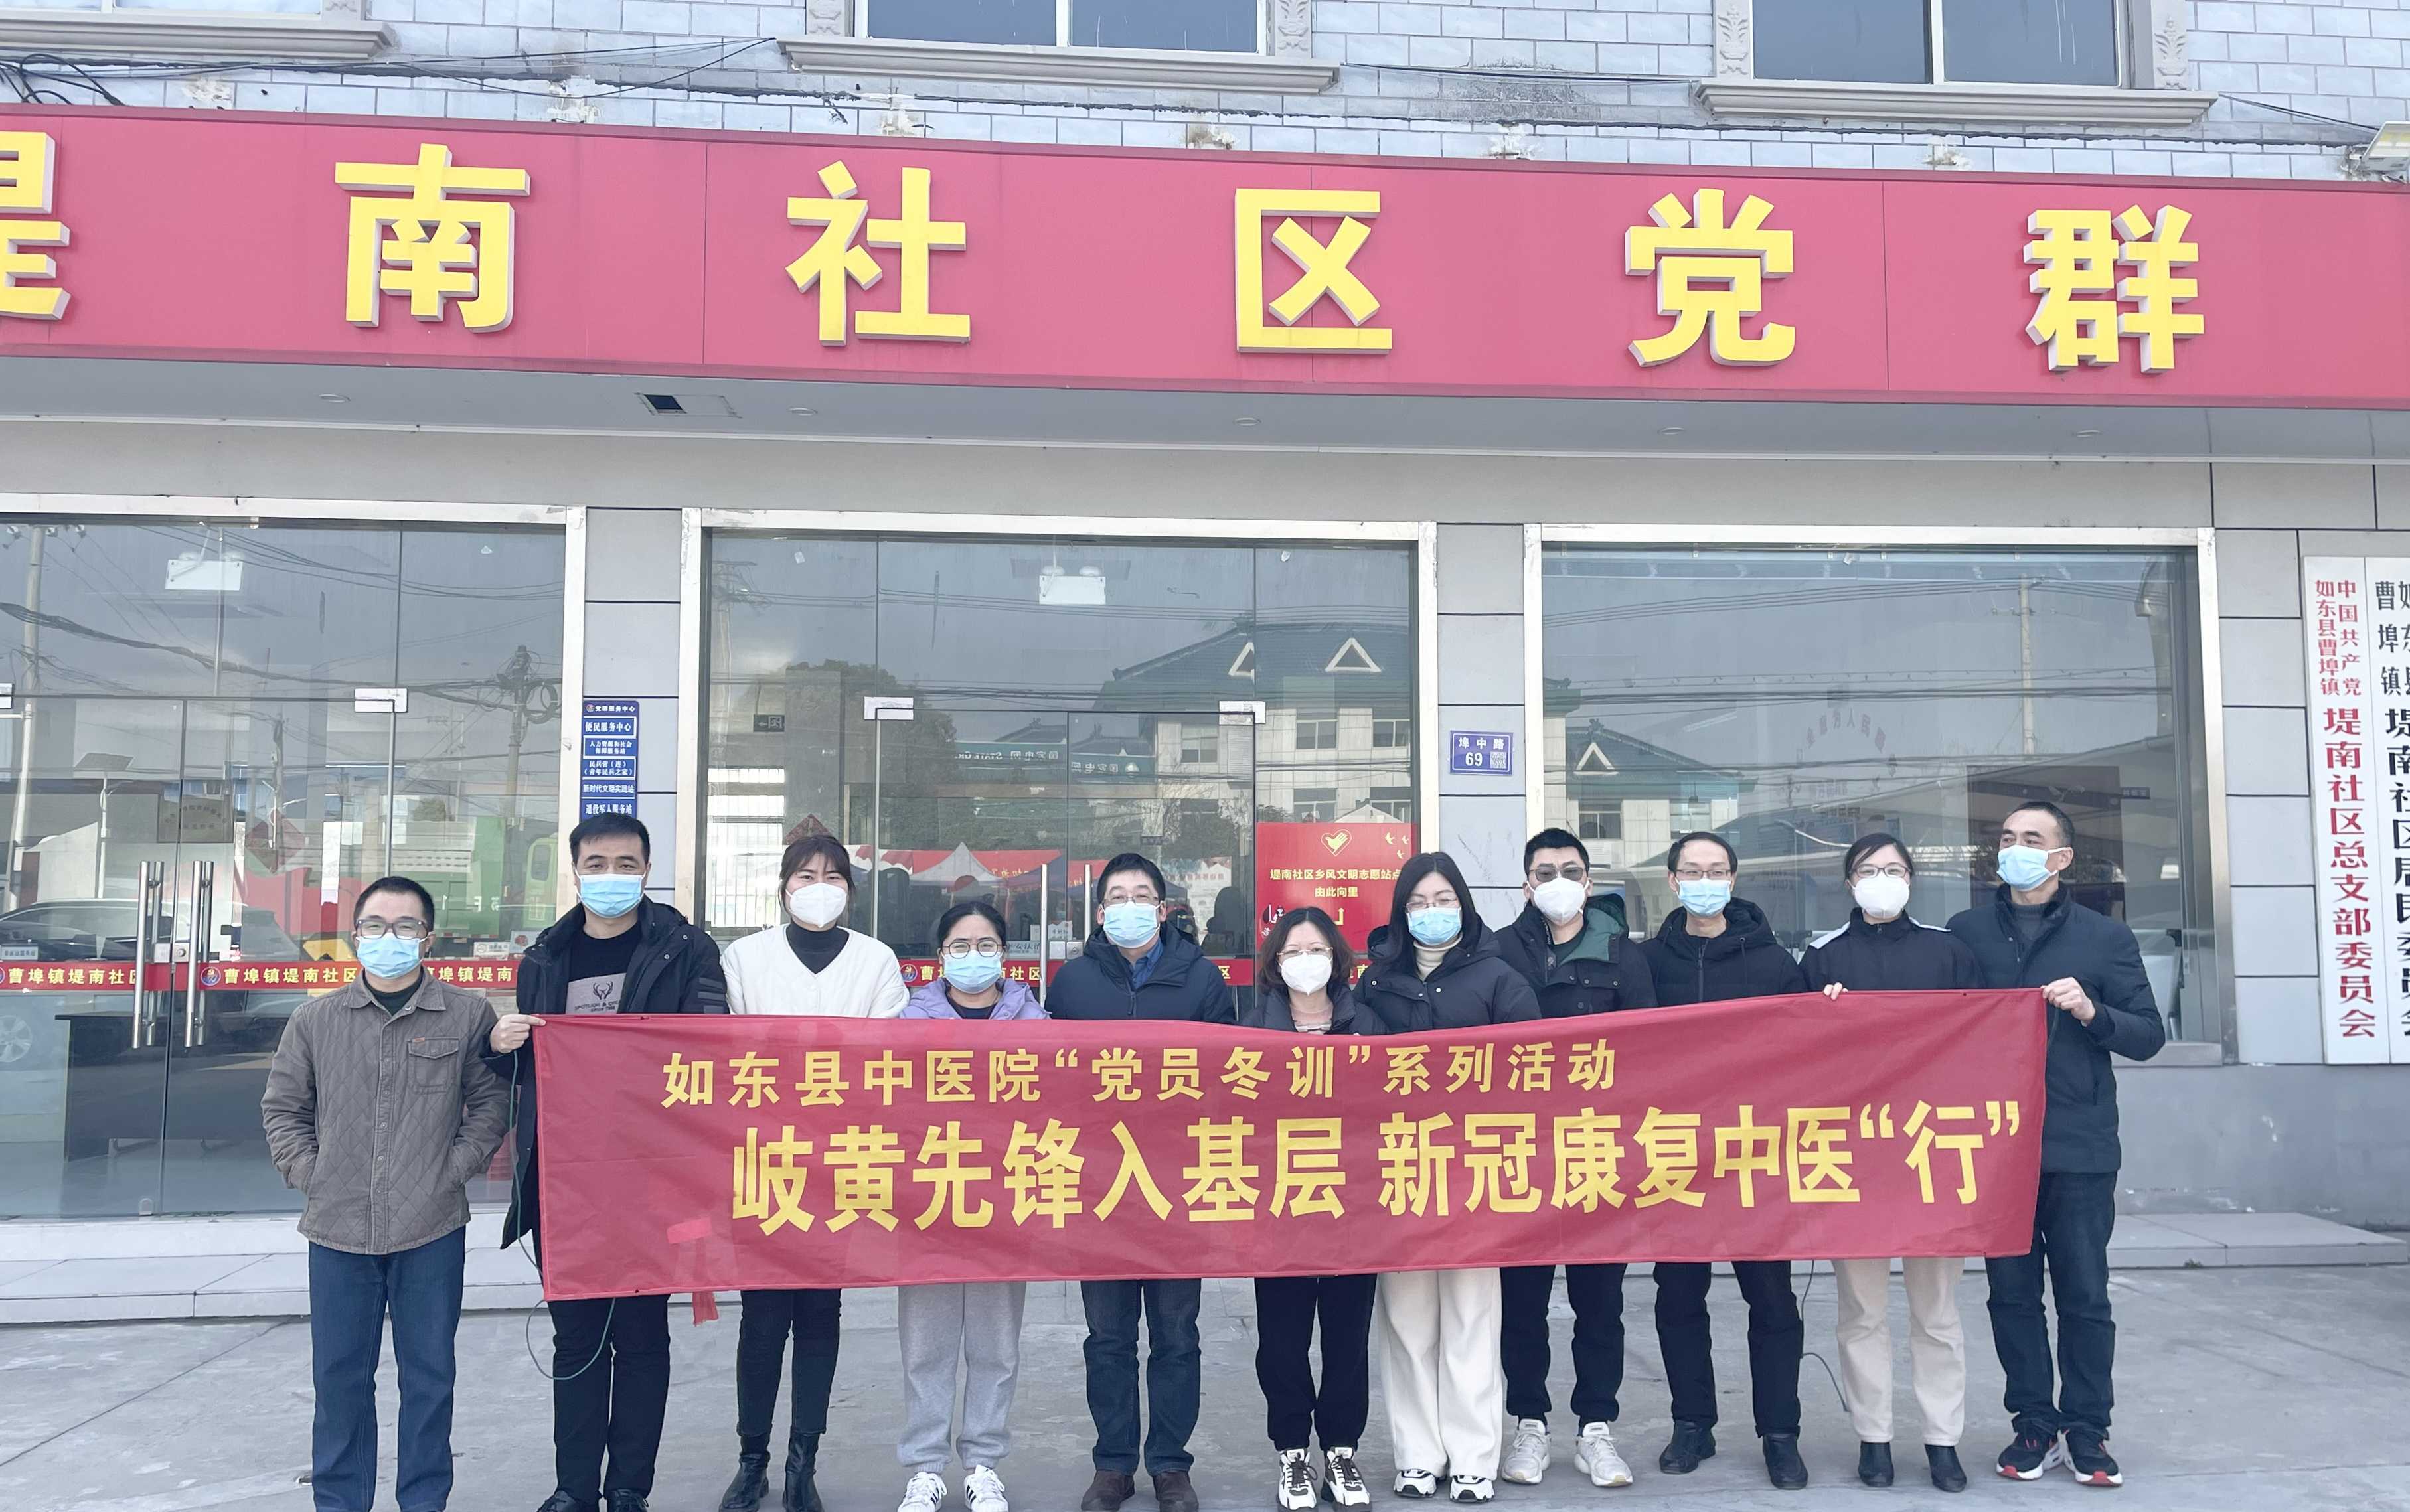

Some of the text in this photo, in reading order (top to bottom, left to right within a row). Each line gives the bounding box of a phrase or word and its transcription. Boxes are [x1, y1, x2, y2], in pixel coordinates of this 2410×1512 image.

[2316, 579, 2340, 696] 如东县曹埠镇
[2338, 579, 2361, 696] 中国共产党
[2375, 581, 2401, 696] 曹埠镇
[585, 721, 631, 732] 便民服务中心
[1458, 737, 1504, 750] 埠中路
[1465, 752, 1483, 766] 69
[1269, 869, 1402, 881] 堤南社区乡风文明志愿站点
[2323, 708, 2375, 1037] 堤南社区总支部委员会
[1314, 886, 1359, 898] 由此向里
[224, 967, 357, 984] 曹埠镇堤南社区
[427, 966, 517, 982] 埠镇堤南
[733, 1100, 2020, 1236] 岐黄先锋入基层 新冠康复中医“行”
